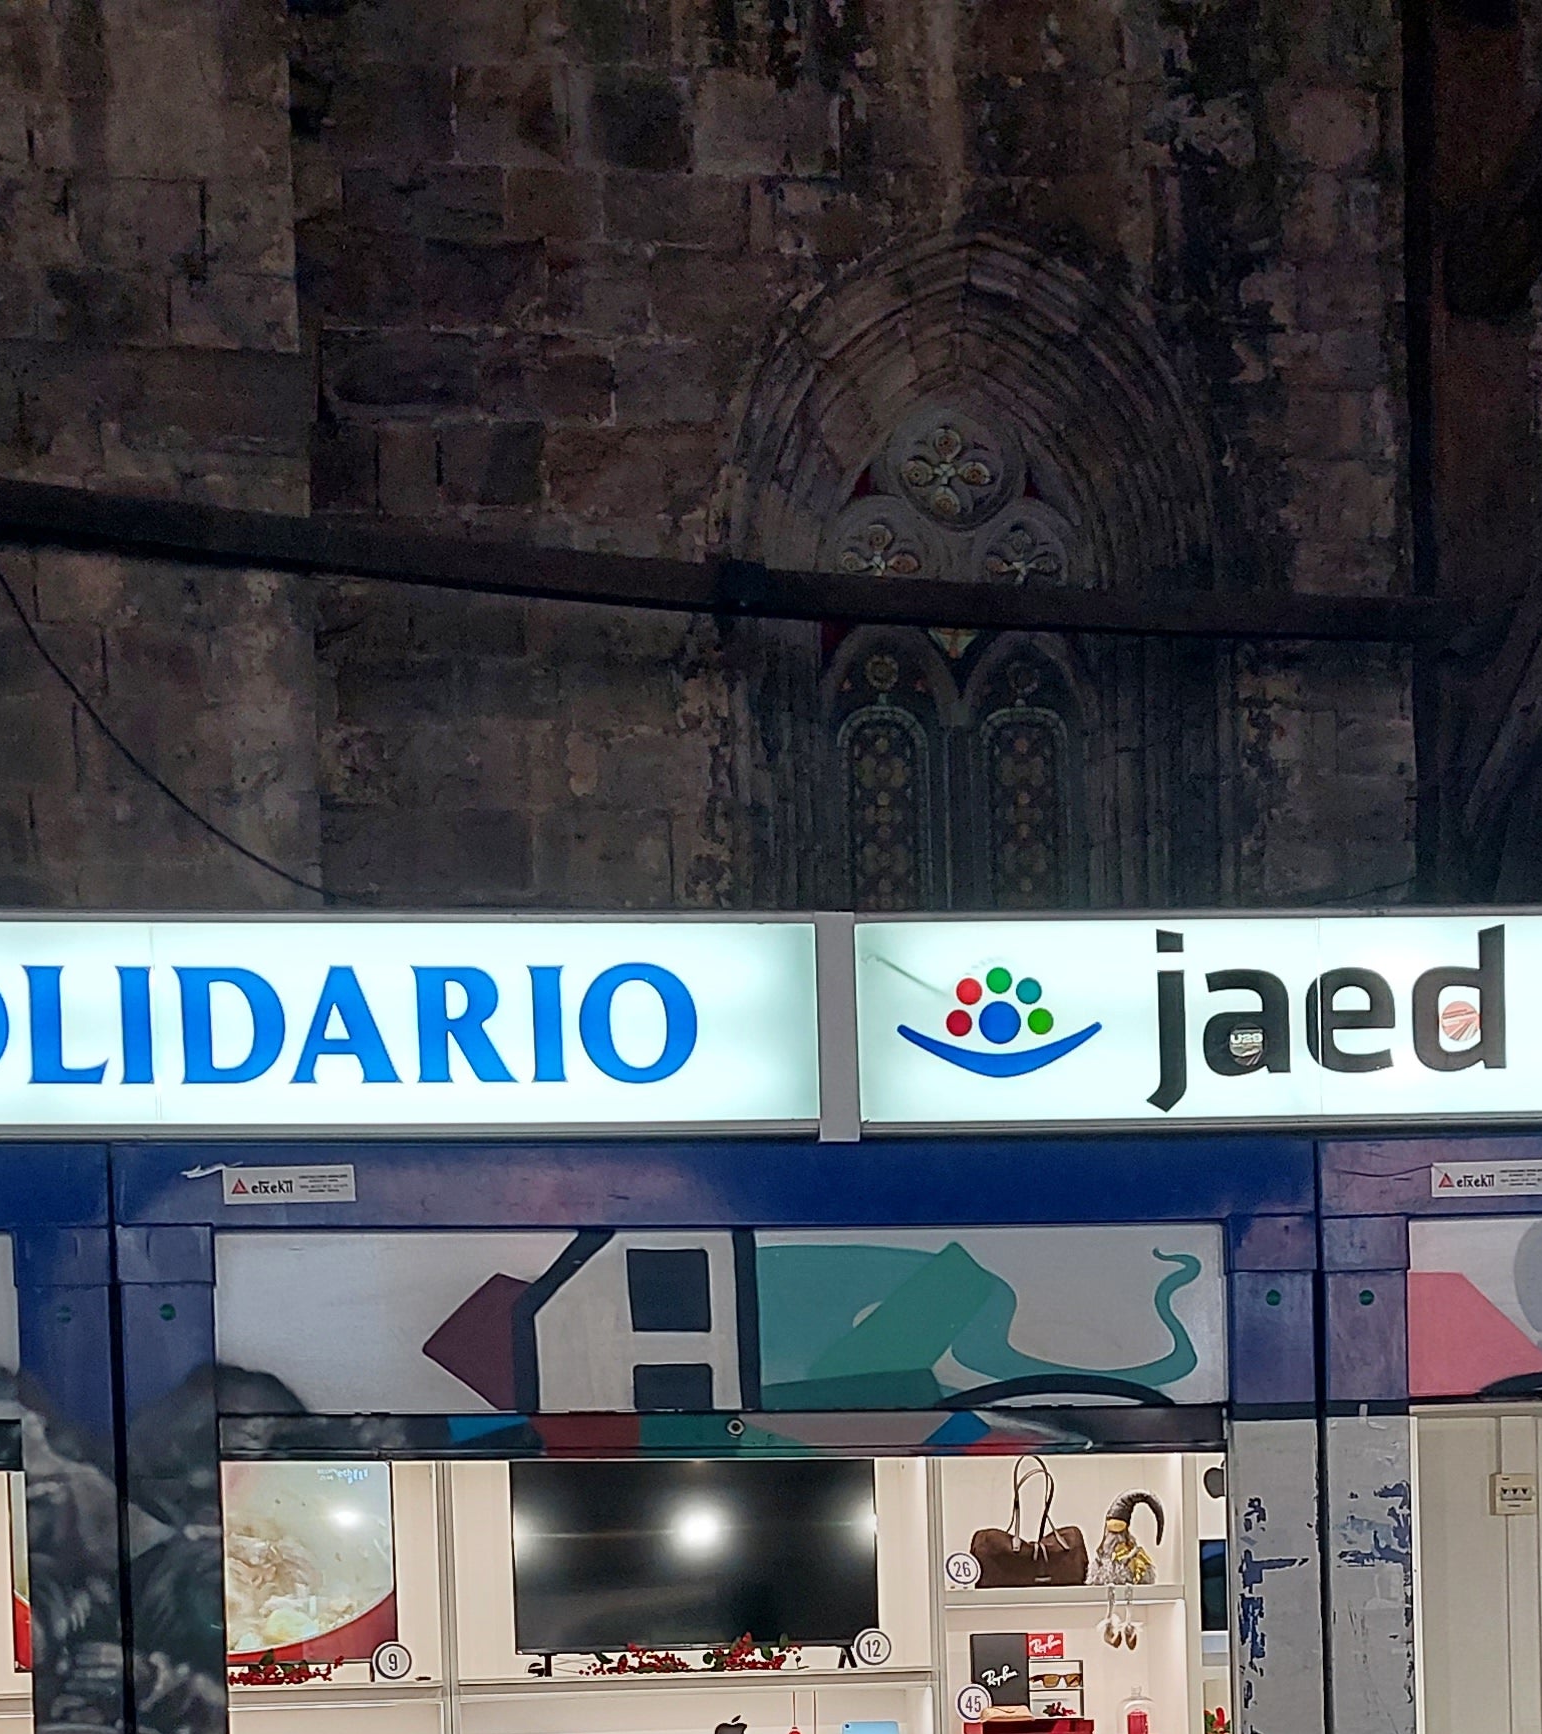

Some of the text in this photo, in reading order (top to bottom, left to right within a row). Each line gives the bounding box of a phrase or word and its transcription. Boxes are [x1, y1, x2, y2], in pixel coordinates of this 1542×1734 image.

[1146, 924, 1507, 1112] jaed
[953, 1561, 971, 1578] 26
[865, 1639, 881, 1658] 12
[389, 1653, 398, 1671] 9
[965, 1695, 981, 1713] 45
